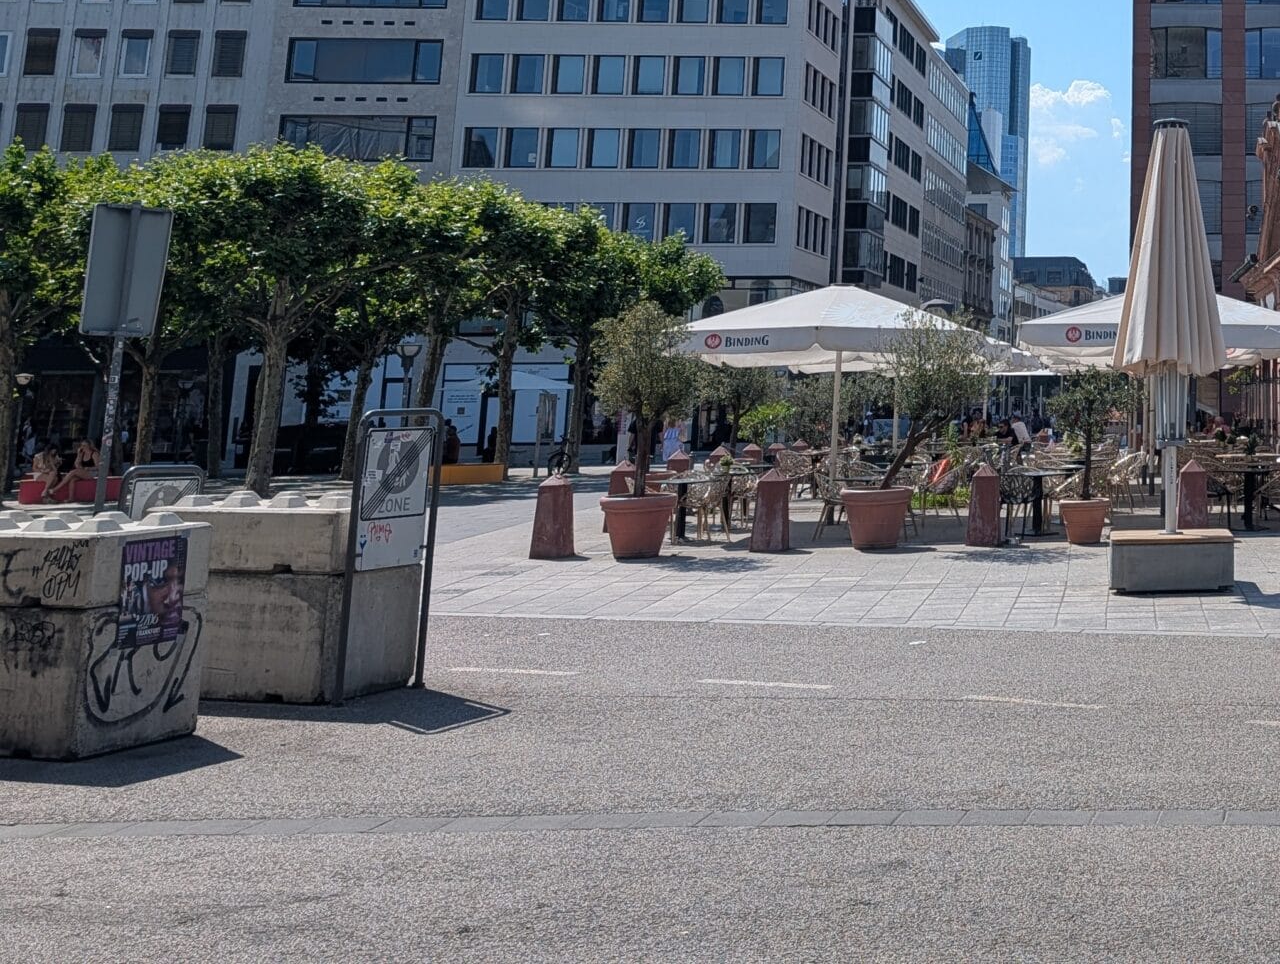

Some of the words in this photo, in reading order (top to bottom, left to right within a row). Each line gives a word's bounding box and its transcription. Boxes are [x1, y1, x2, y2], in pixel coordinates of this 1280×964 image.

[724, 334, 769, 348] BINDING
[377, 497, 411, 514] ZONE
[126, 539, 176, 564] VINTAGE
[124, 559, 168, 583] POP-UP
